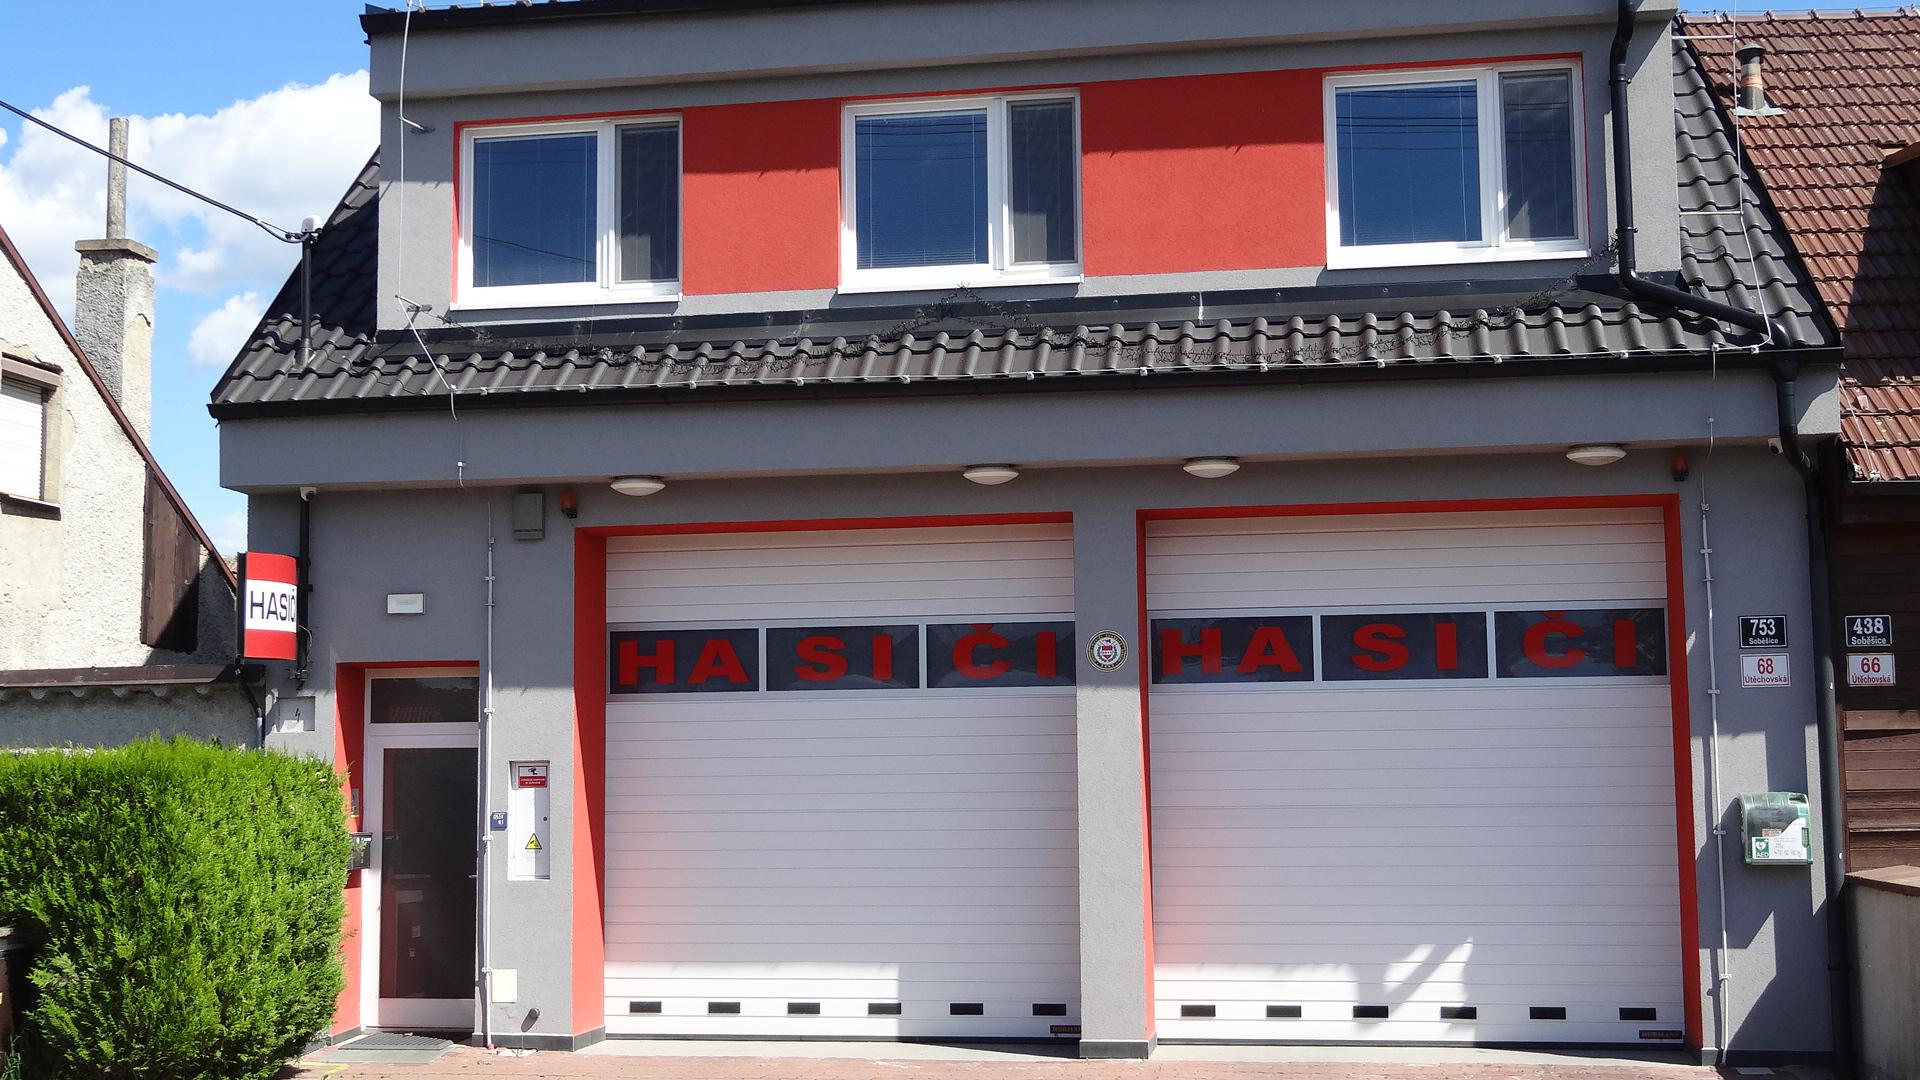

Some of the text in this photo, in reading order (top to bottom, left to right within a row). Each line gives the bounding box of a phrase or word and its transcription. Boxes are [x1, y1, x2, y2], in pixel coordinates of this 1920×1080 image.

[1750, 619, 1776, 636] 753
[1853, 617, 1884, 634] 438
[1749, 637, 1779, 645] Soběšice
[1851, 635, 1887, 645] Soběšice
[1757, 657, 1774, 674] 68
[1861, 657, 1881, 673] 66
[1852, 673, 1891, 684] Útěchovská
